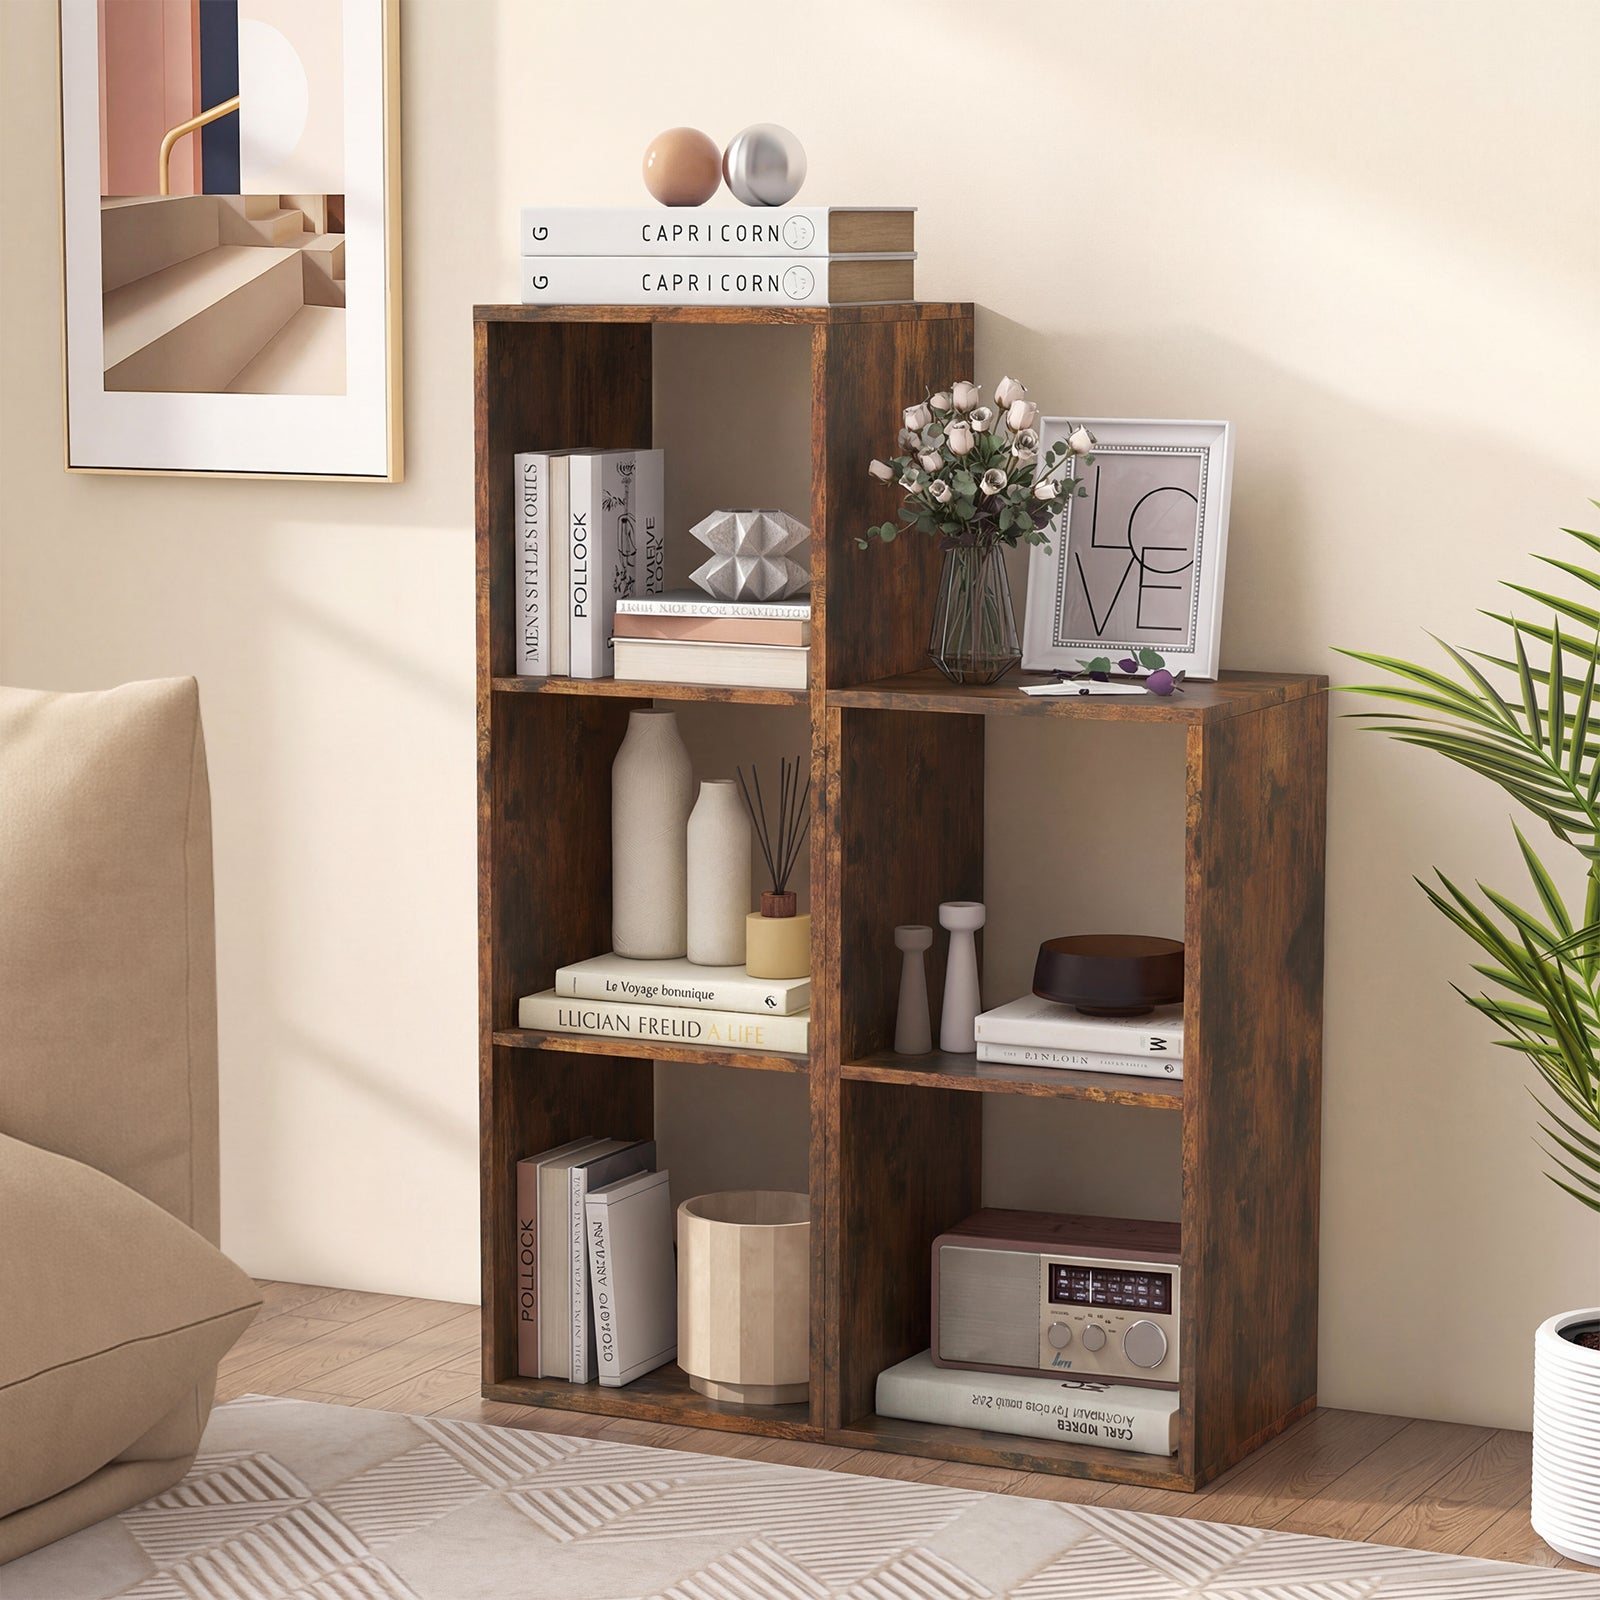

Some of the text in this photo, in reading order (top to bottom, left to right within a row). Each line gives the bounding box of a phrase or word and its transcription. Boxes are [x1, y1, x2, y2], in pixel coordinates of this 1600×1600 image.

[532, 226, 549, 241] G
[642, 224, 779, 242] CAPRICORN
[532, 275, 549, 290] G
[642, 273, 779, 292] CAPRICORN
[573, 512, 588, 618] POLLOCK
[621, 981, 659, 998] Voyage
[707, 1023, 721, 1041] A
[728, 1023, 766, 1045] LIFE
[520, 1218, 534, 1323] POLLOCK
